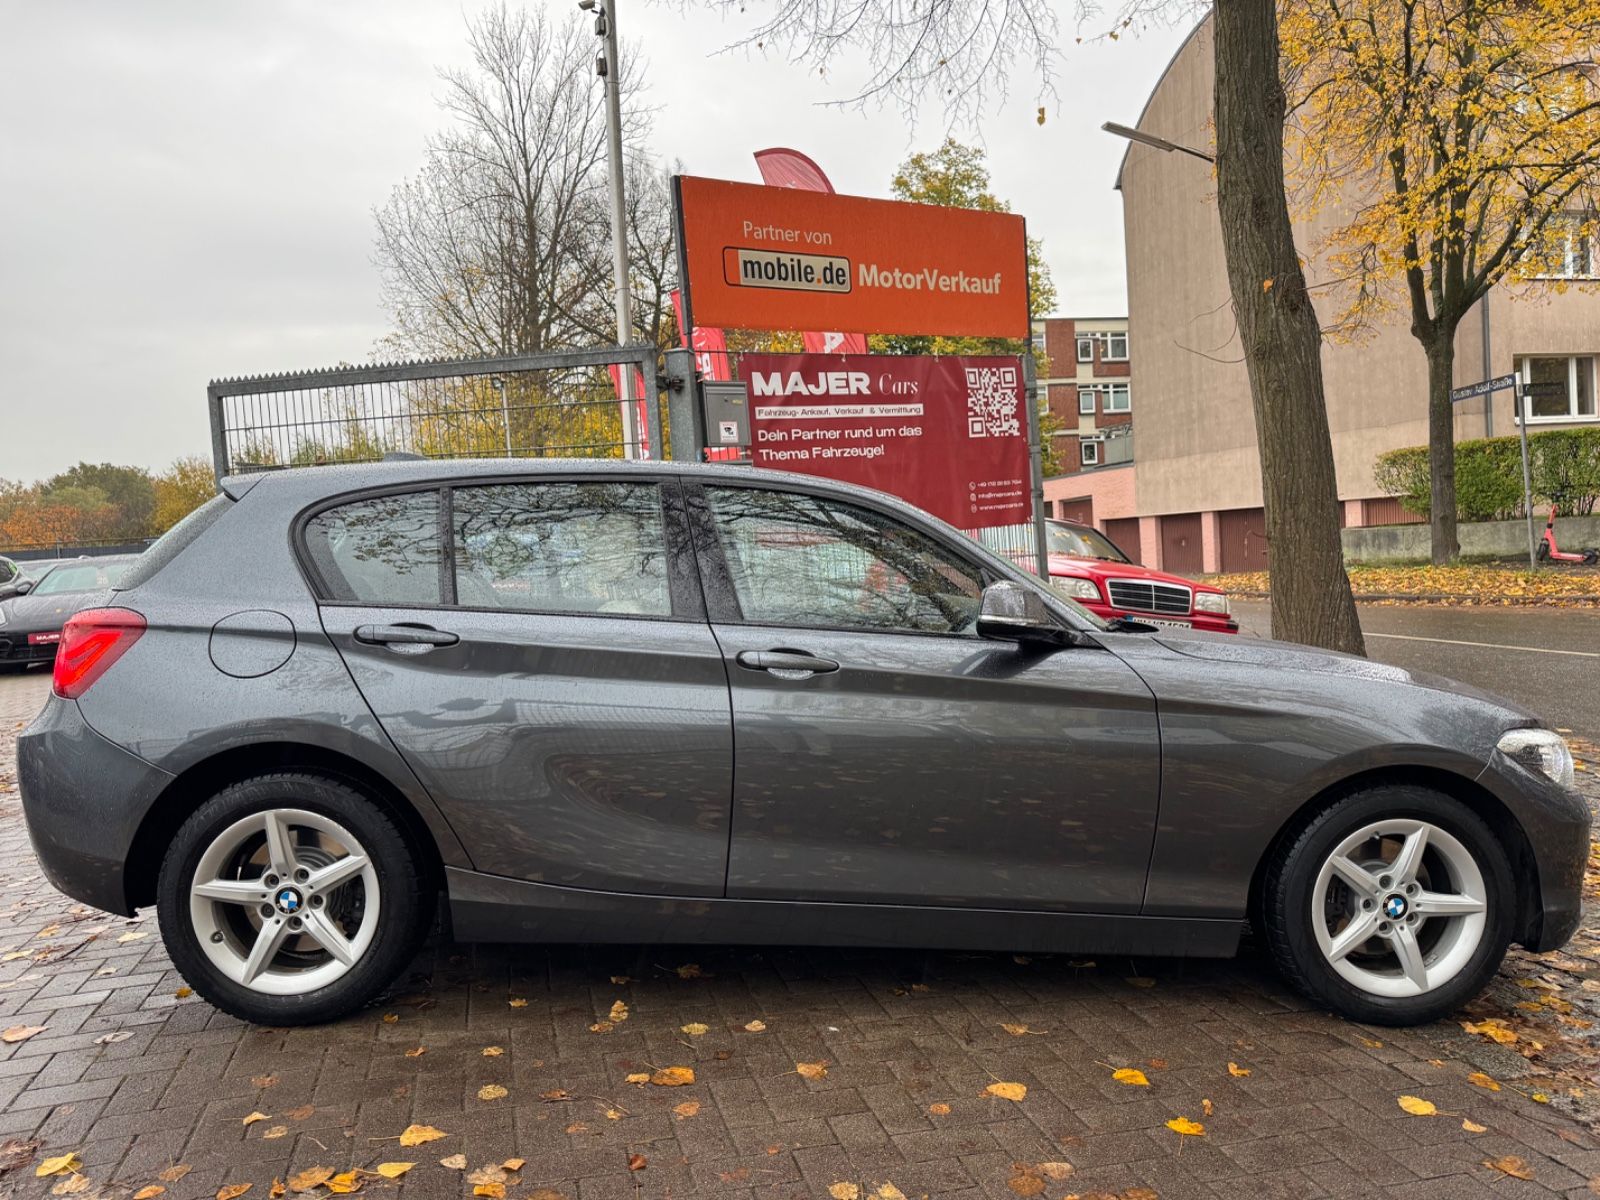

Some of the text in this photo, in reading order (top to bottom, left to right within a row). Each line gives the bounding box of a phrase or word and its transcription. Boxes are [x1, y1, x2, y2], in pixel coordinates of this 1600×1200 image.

[743, 220, 832, 246] Partner von
[742, 256, 1002, 295] mobile.de MotorVerkauf
[751, 371, 919, 397] MAJER Cars
[834, 407, 865, 416] Verkauf
[869, 406, 876, 415] &
[878, 405, 922, 416] Vermittlung
[757, 425, 923, 442] Dein Partner rund um das
[759, 444, 885, 461] Thema Fahrzeuge!
